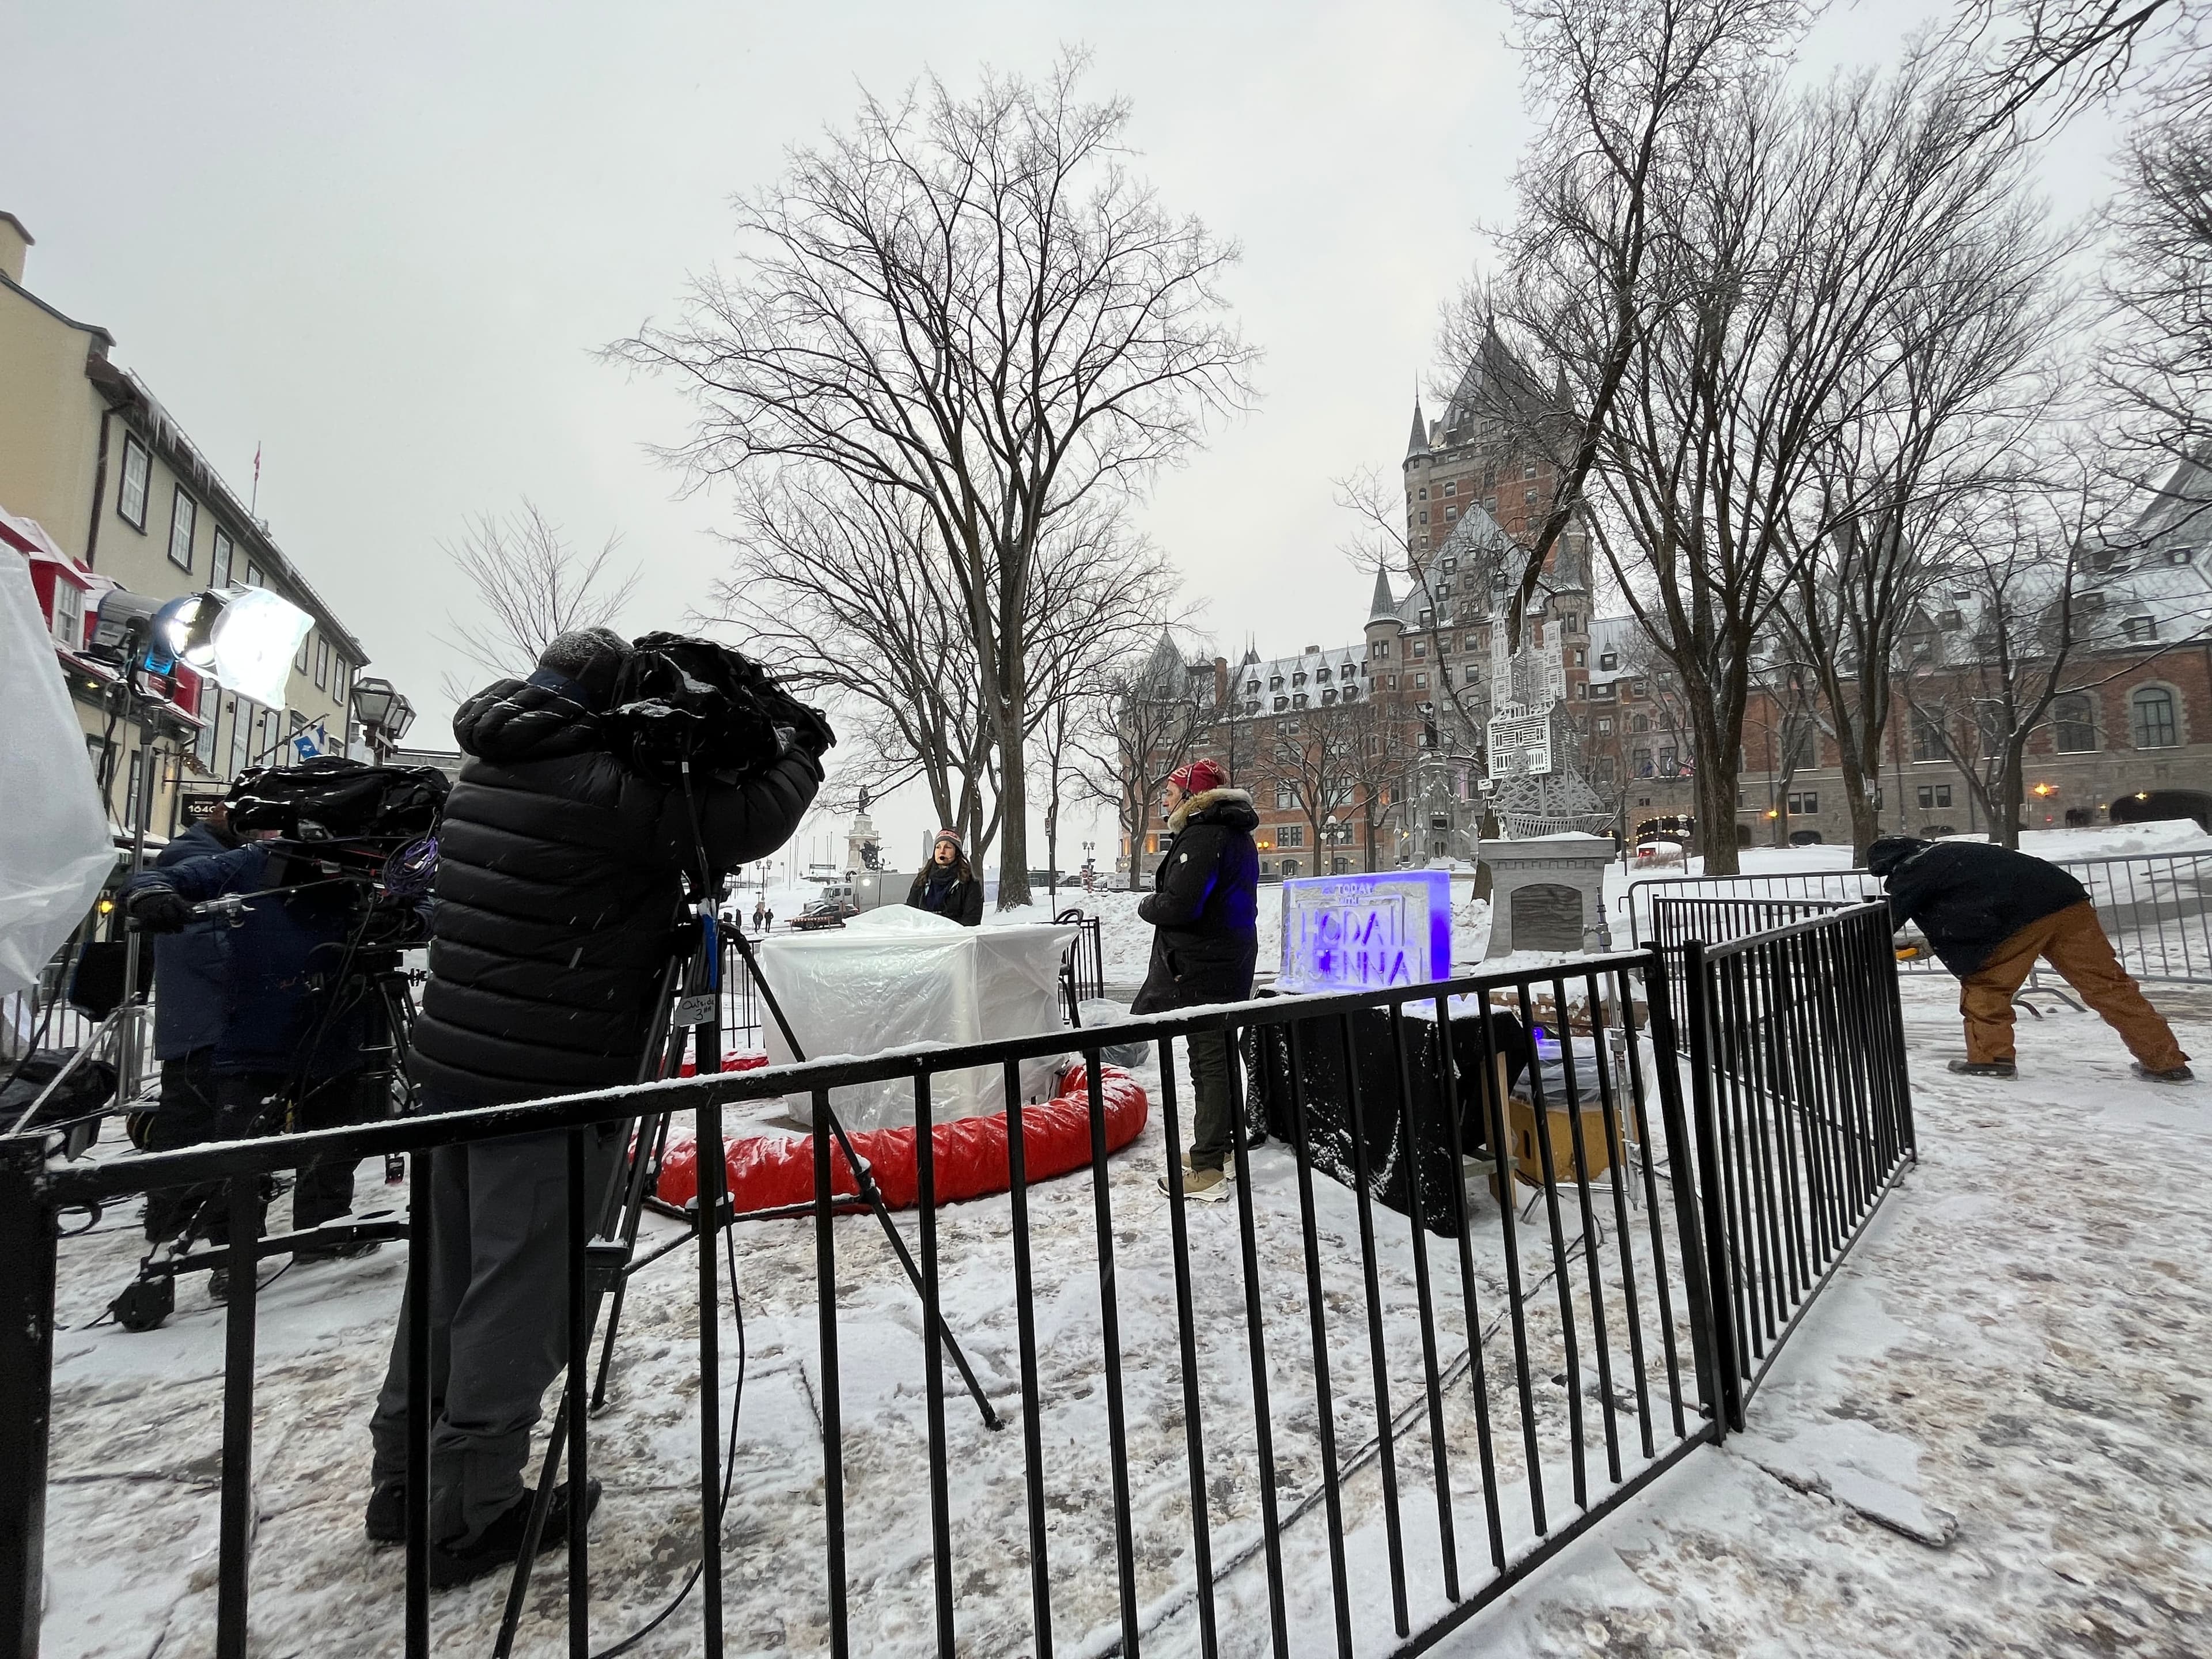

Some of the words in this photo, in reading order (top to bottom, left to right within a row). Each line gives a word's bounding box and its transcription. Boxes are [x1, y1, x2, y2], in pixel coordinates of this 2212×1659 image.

[1335, 882, 1373, 895] TODAY
[1339, 896, 1359, 906] WITH
[1301, 908, 1384, 946] HODA
[1308, 949, 1411, 986] JENNA
